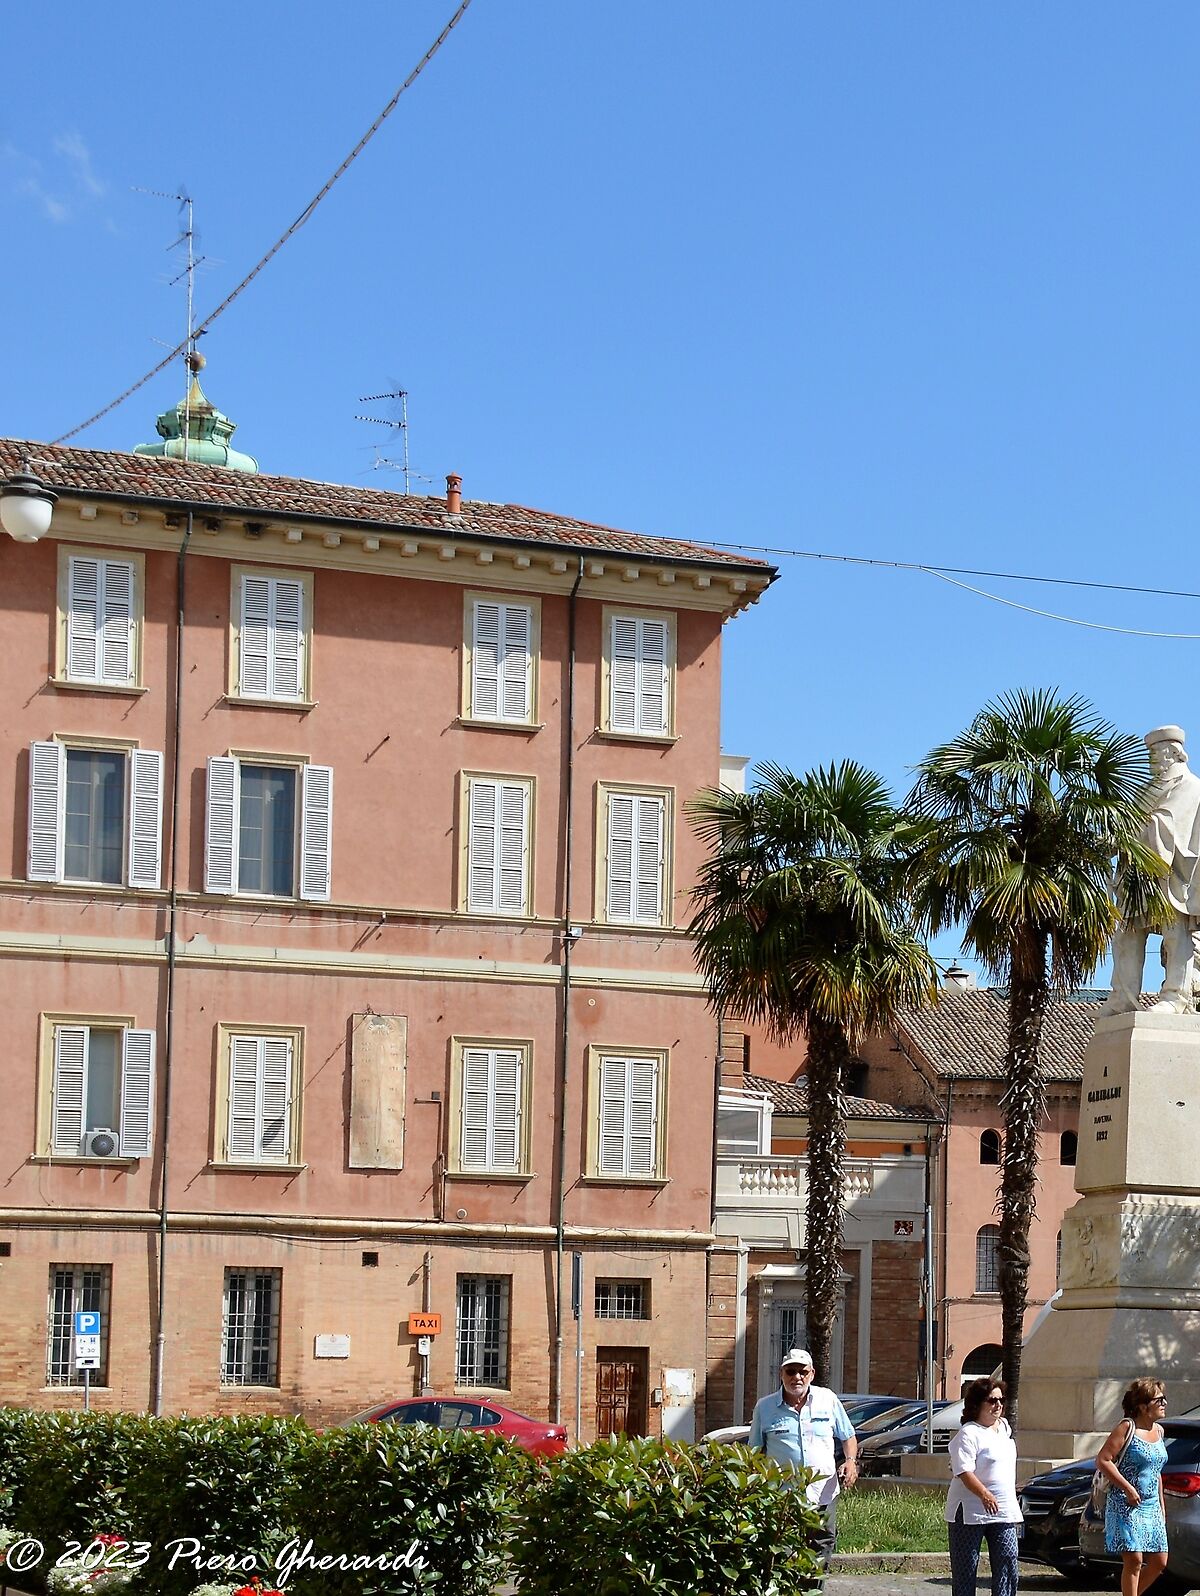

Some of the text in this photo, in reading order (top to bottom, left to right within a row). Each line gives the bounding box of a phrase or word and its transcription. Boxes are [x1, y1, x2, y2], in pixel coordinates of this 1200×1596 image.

[1087, 1086, 1122, 1103] GARIBALDI
[80, 1314, 96, 1332] P
[413, 1319, 438, 1328] TAXI
